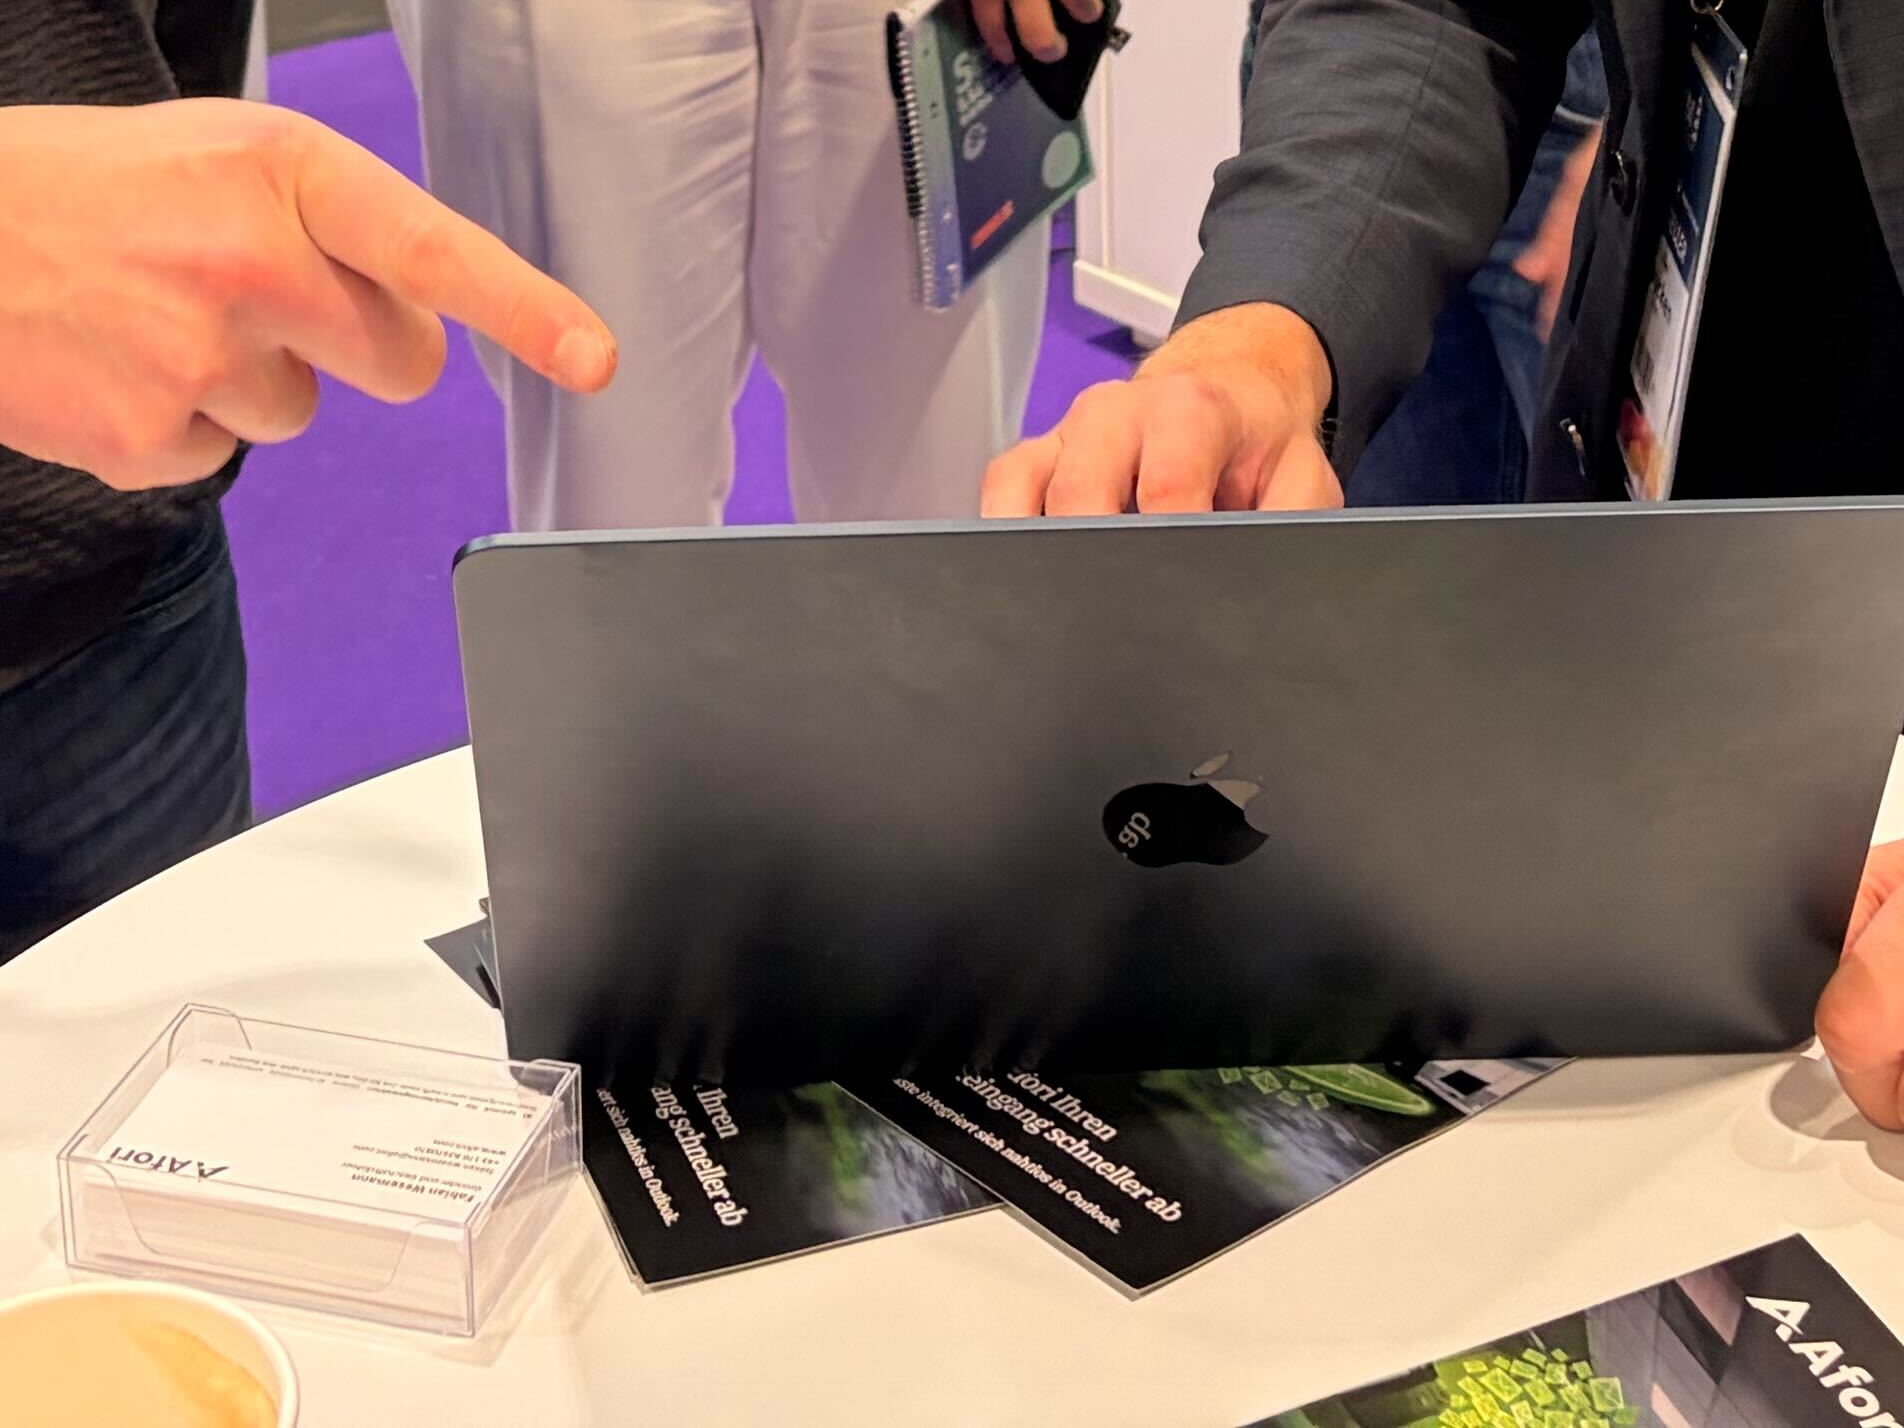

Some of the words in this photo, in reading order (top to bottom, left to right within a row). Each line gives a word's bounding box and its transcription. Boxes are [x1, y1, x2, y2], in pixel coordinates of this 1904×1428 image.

[669, 1118, 731, 1201] schneller
[713, 1199, 749, 1227] ab
[1044, 1125, 1155, 1200] schneller
[1145, 1196, 1183, 1223] ab
